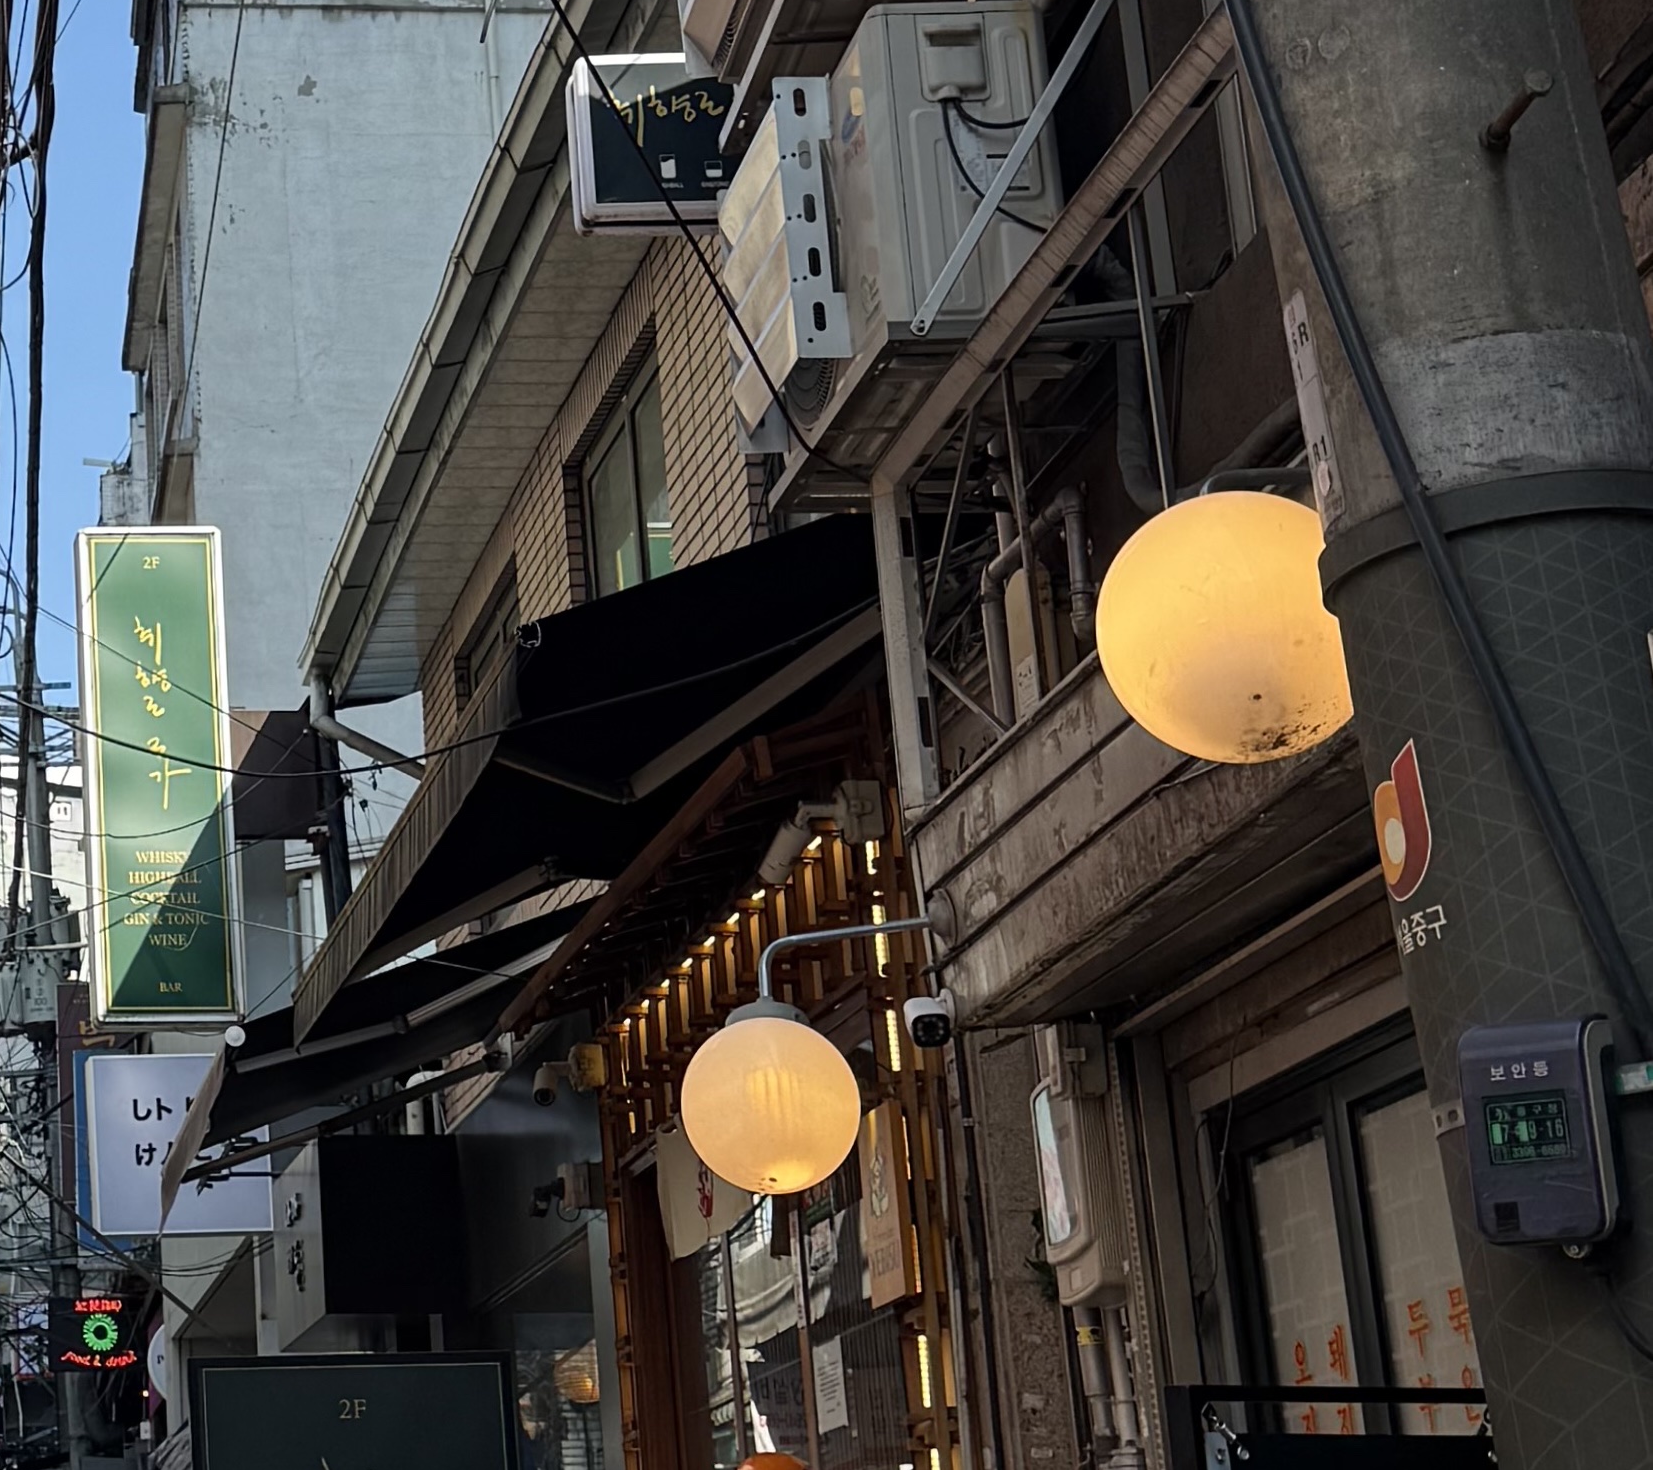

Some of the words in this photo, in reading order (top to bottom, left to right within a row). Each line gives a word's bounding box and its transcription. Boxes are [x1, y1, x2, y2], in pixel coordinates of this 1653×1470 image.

[143, 556, 160, 570] 2F
[124, 912, 149, 926] GIN
[164, 912, 211, 925] TONIC
[1396, 904, 1448, 956] 울중구
[149, 933, 189, 947] WINE
[159, 982, 183, 993] BAR
[338, 1399, 367, 1420] 2F
